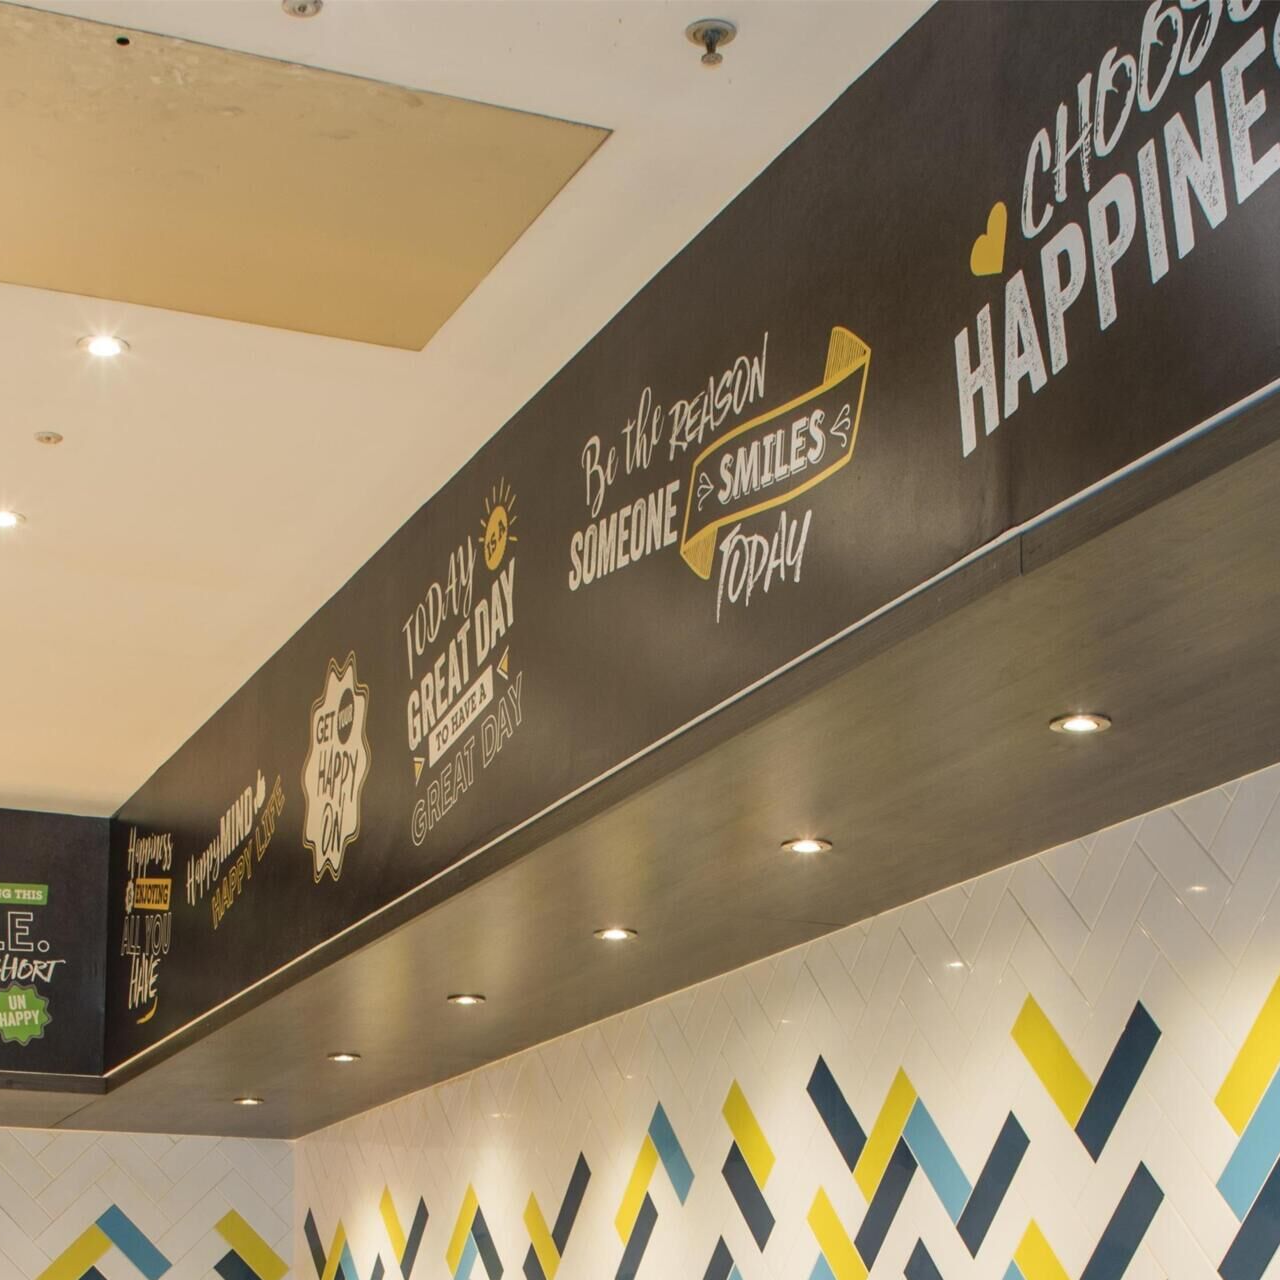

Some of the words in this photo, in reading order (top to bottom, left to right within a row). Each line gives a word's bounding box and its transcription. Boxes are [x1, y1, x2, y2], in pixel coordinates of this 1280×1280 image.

[1021, 0, 1261, 239] CHOOS
[581, 435, 618, 518] Be
[621, 386, 664, 475] the
[668, 331, 769, 462] REASON
[718, 408, 827, 505] SMILES
[486, 533, 498, 561] IS
[497, 518, 507, 540] A
[568, 479, 680, 591] SOMEONE
[716, 509, 813, 624] TODAY
[402, 535, 477, 680] TODAY
[407, 618, 471, 751] GREAT
[474, 556, 516, 668] DAY
[316, 710, 336, 745] GET
[435, 724, 451, 752] TO
[450, 695, 478, 739] HAVE
[478, 683, 487, 705] A
[317, 744, 358, 807] HAPPY
[411, 735, 475, 847] GREAT
[481, 670, 523, 769] DAY
[128, 825, 173, 879] Happiness
[186, 834, 221, 907] Happy
[220, 785, 254, 863] MIND
[210, 838, 254, 931] HAPPY
[255, 774, 286, 863] LIFE
[321, 791, 346, 857] ON
[14, 889, 43, 900] THIS
[135, 884, 169, 905] ENJOYING
[120, 915, 141, 956] ALL
[145, 912, 172, 956] YOU
[8, 994, 27, 1010] UN
[127, 952, 161, 1009] HAVE
